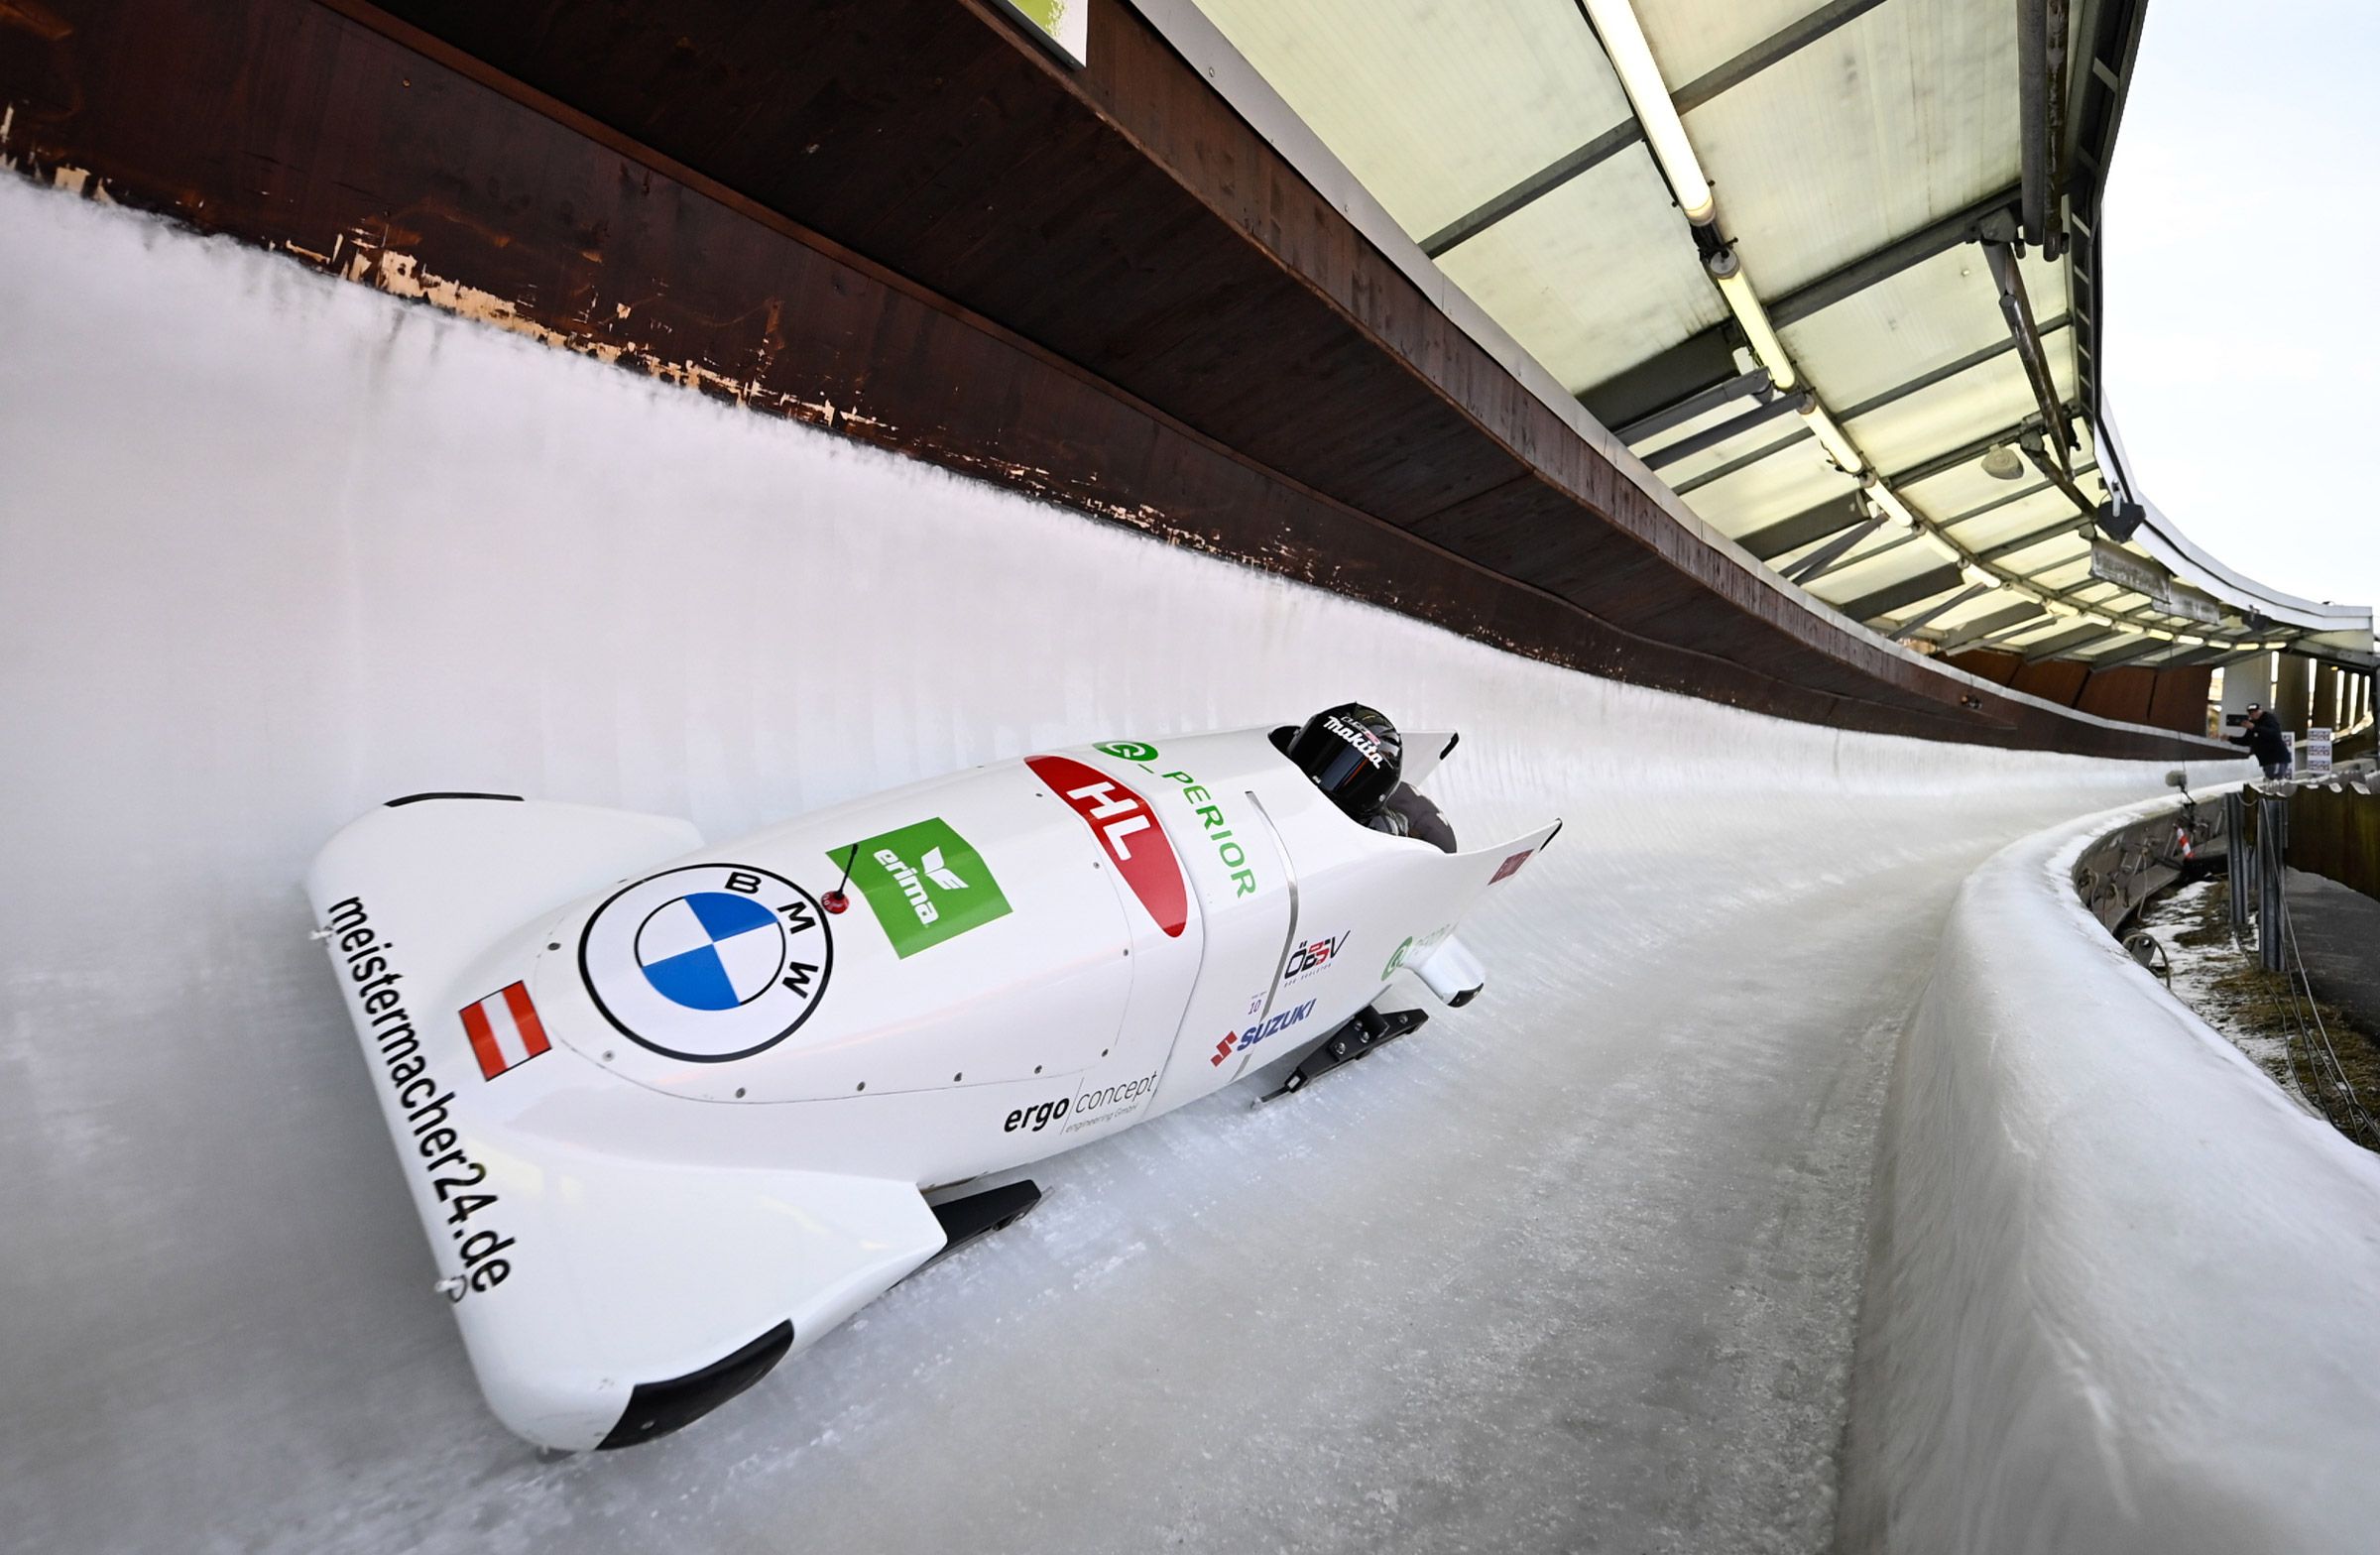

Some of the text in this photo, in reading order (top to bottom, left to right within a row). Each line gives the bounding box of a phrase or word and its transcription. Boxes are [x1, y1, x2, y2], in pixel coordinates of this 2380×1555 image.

[1067, 781, 1151, 862] HL
[874, 849, 940, 926] erima
[725, 871, 818, 999] BMW
[1284, 930, 1351, 979] ÖBSV
[1237, 998, 1317, 1051] SUZUKI
[328, 896, 515, 1293] meistermacher24.de
[1004, 1071, 1157, 1133] ergo concept
